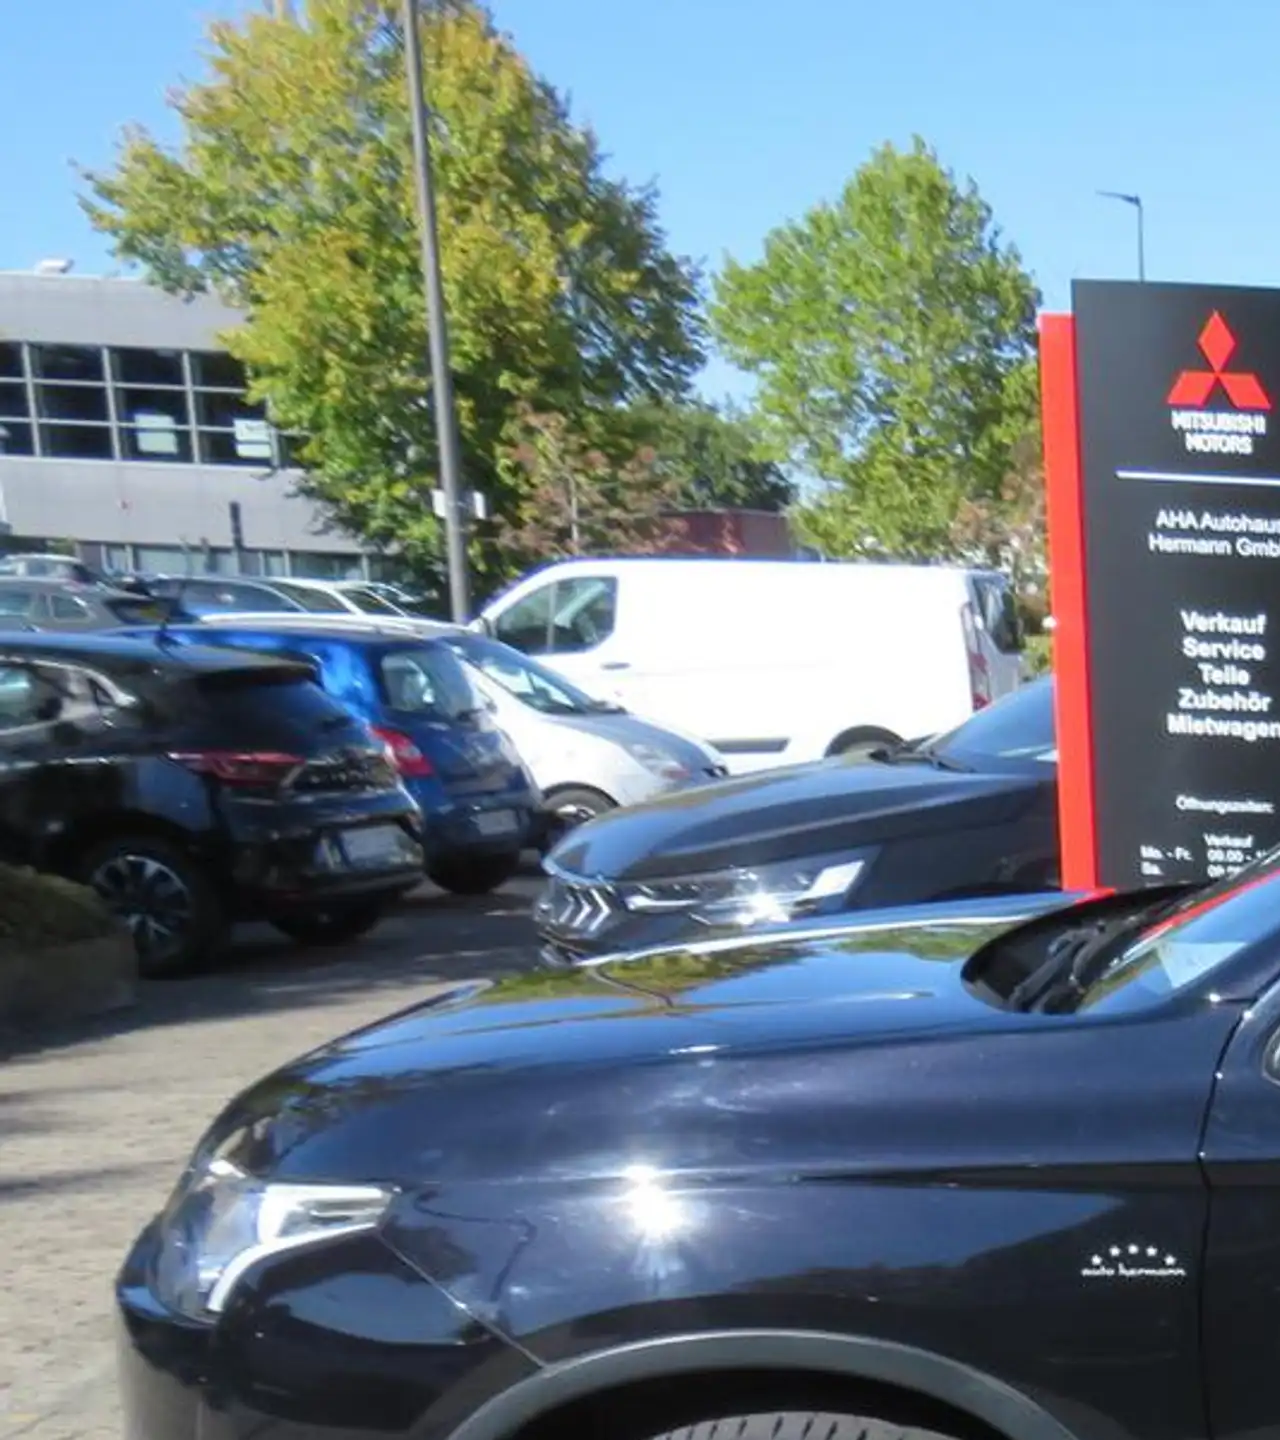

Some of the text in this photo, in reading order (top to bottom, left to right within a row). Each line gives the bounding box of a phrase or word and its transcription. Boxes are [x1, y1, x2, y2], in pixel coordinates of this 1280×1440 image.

[1171, 409, 1267, 435] MITSUBISHI
[1185, 432, 1253, 456] MOTORS
[1156, 508, 1199, 531] AHA
[1148, 532, 1232, 556] Hermann
[1180, 610, 1267, 635] Verkauf
[1182, 635, 1266, 661] Service
[1198, 662, 1251, 686] Teile
[1178, 687, 1273, 713] Zubehör
